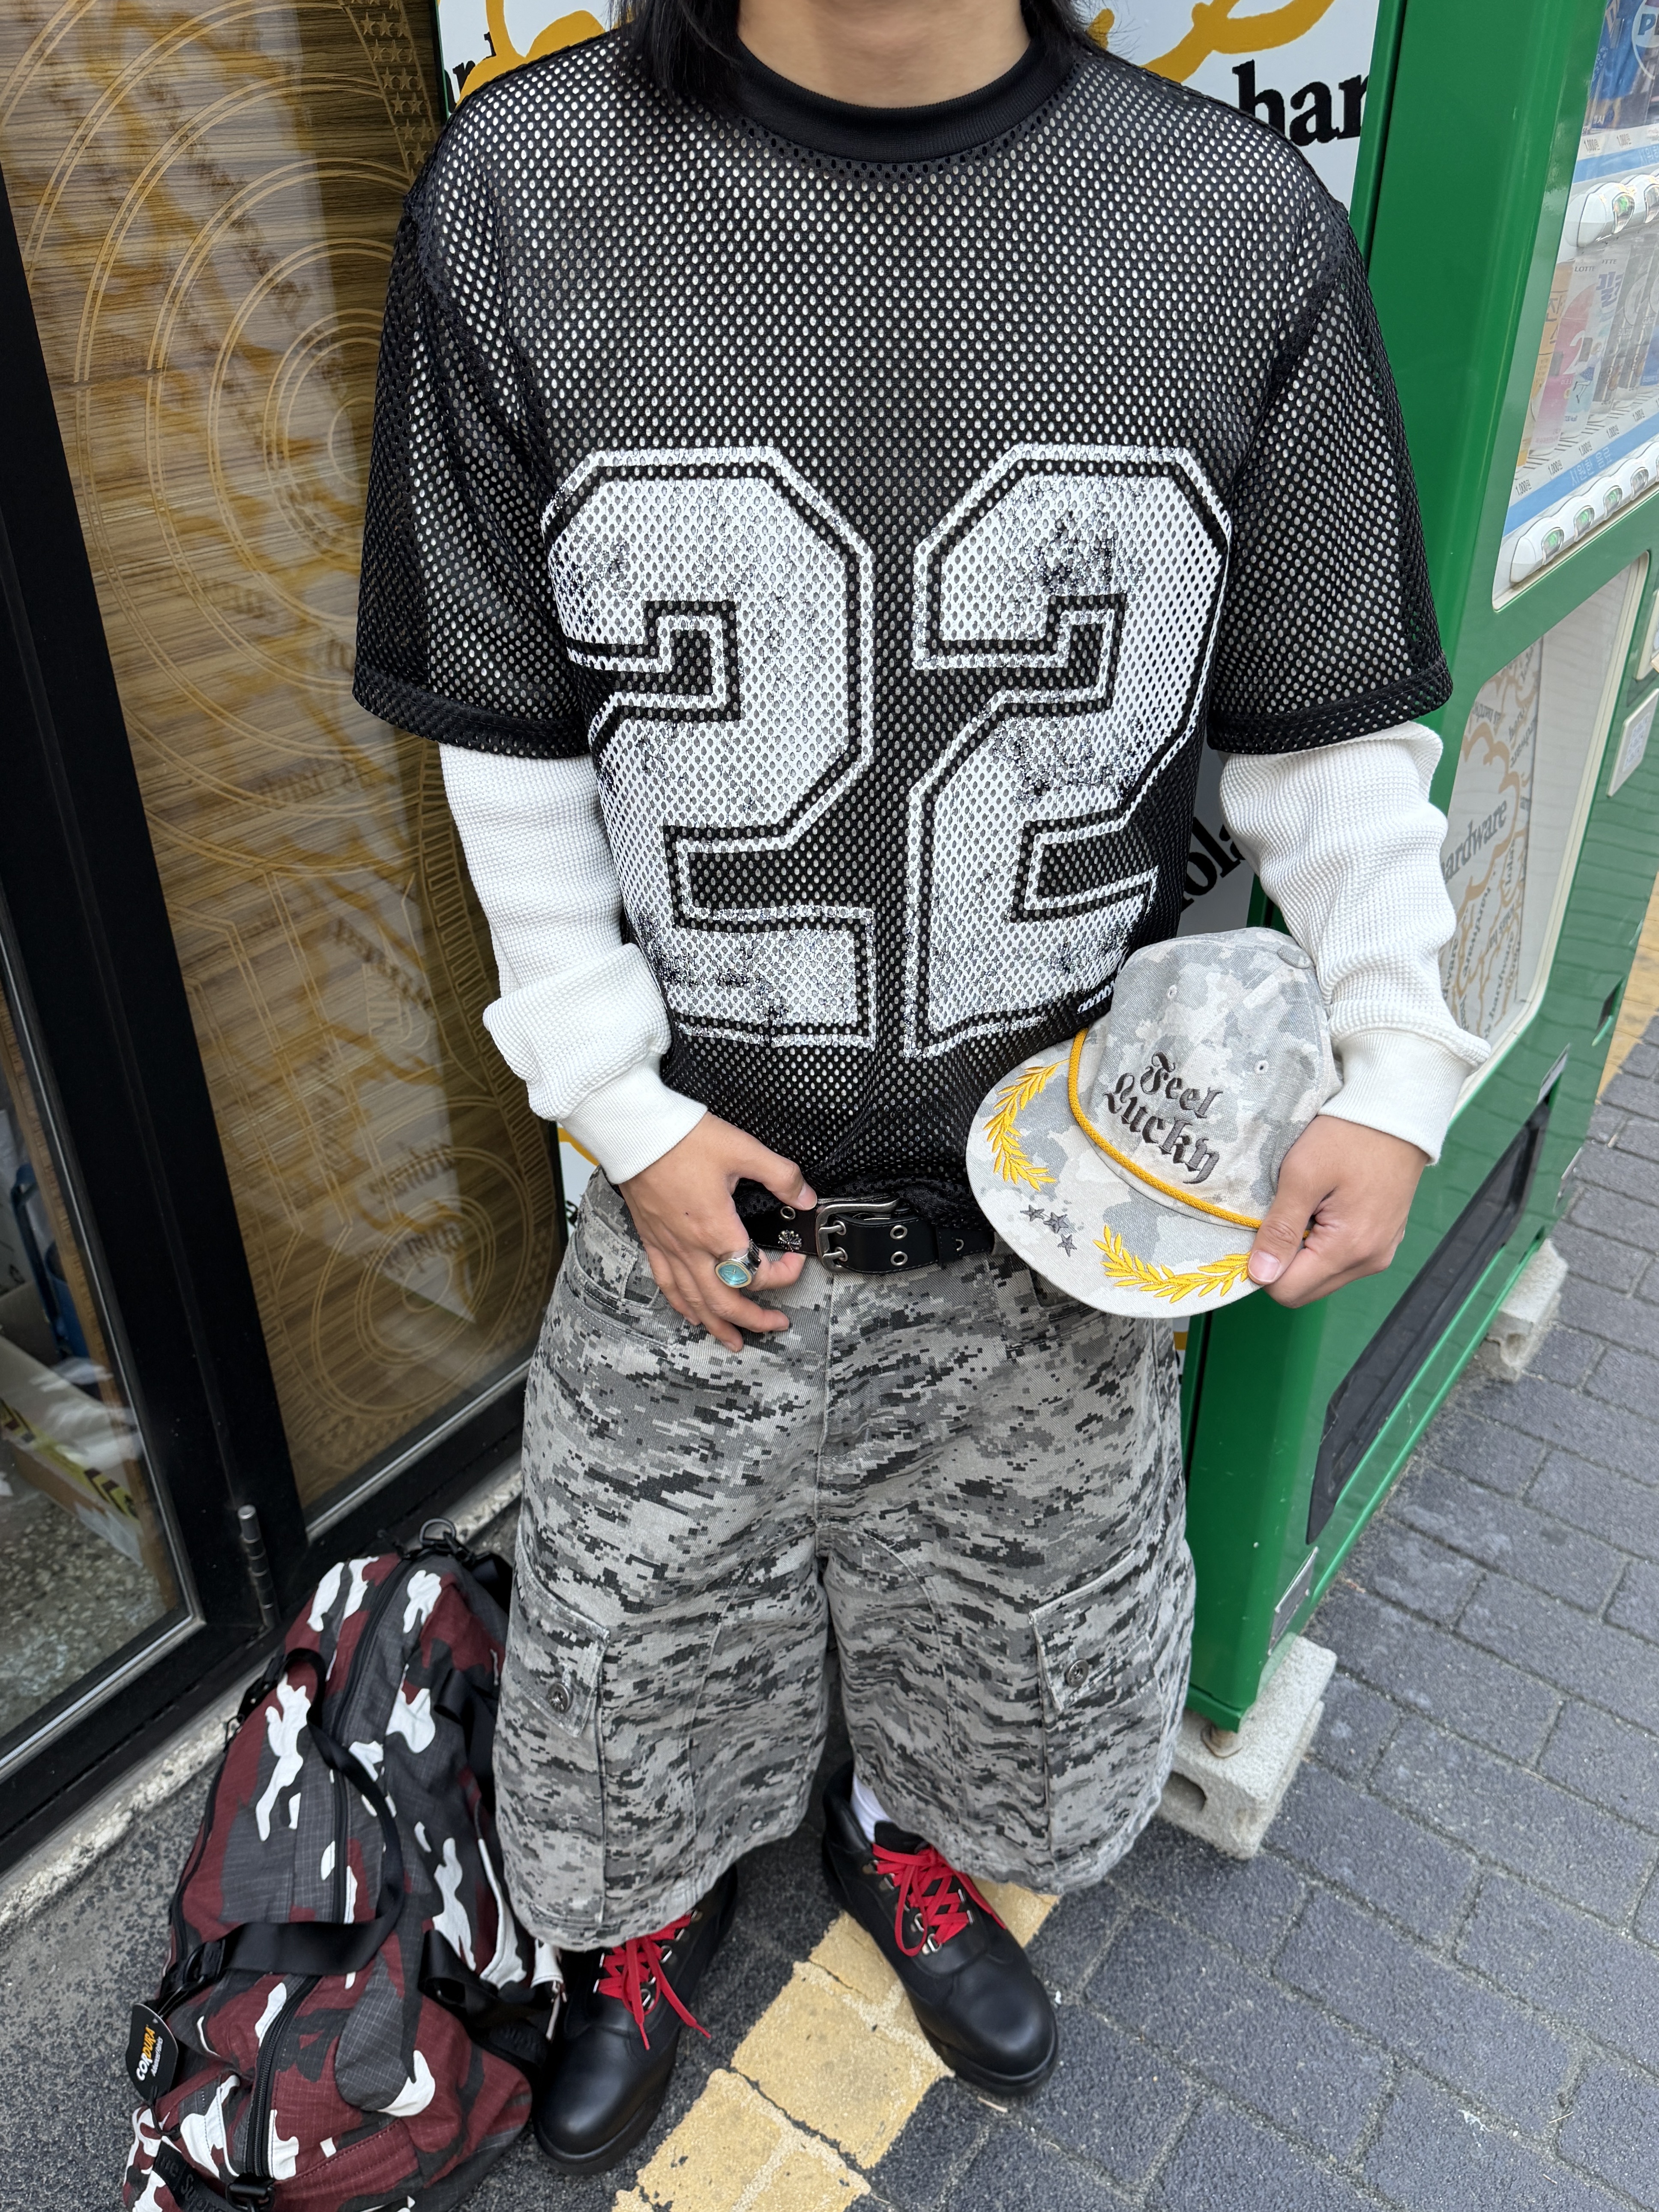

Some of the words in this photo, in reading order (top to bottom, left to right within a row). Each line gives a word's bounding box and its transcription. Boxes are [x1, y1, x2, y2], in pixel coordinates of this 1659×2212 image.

[1570, 458, 1594, 486] 시원한
[1596, 447, 1612, 468] 음료
[540, 443, 1232, 1057] 22
[1140, 1052, 1223, 1119] Feel
[136, 2026, 156, 2081] CORDURA
